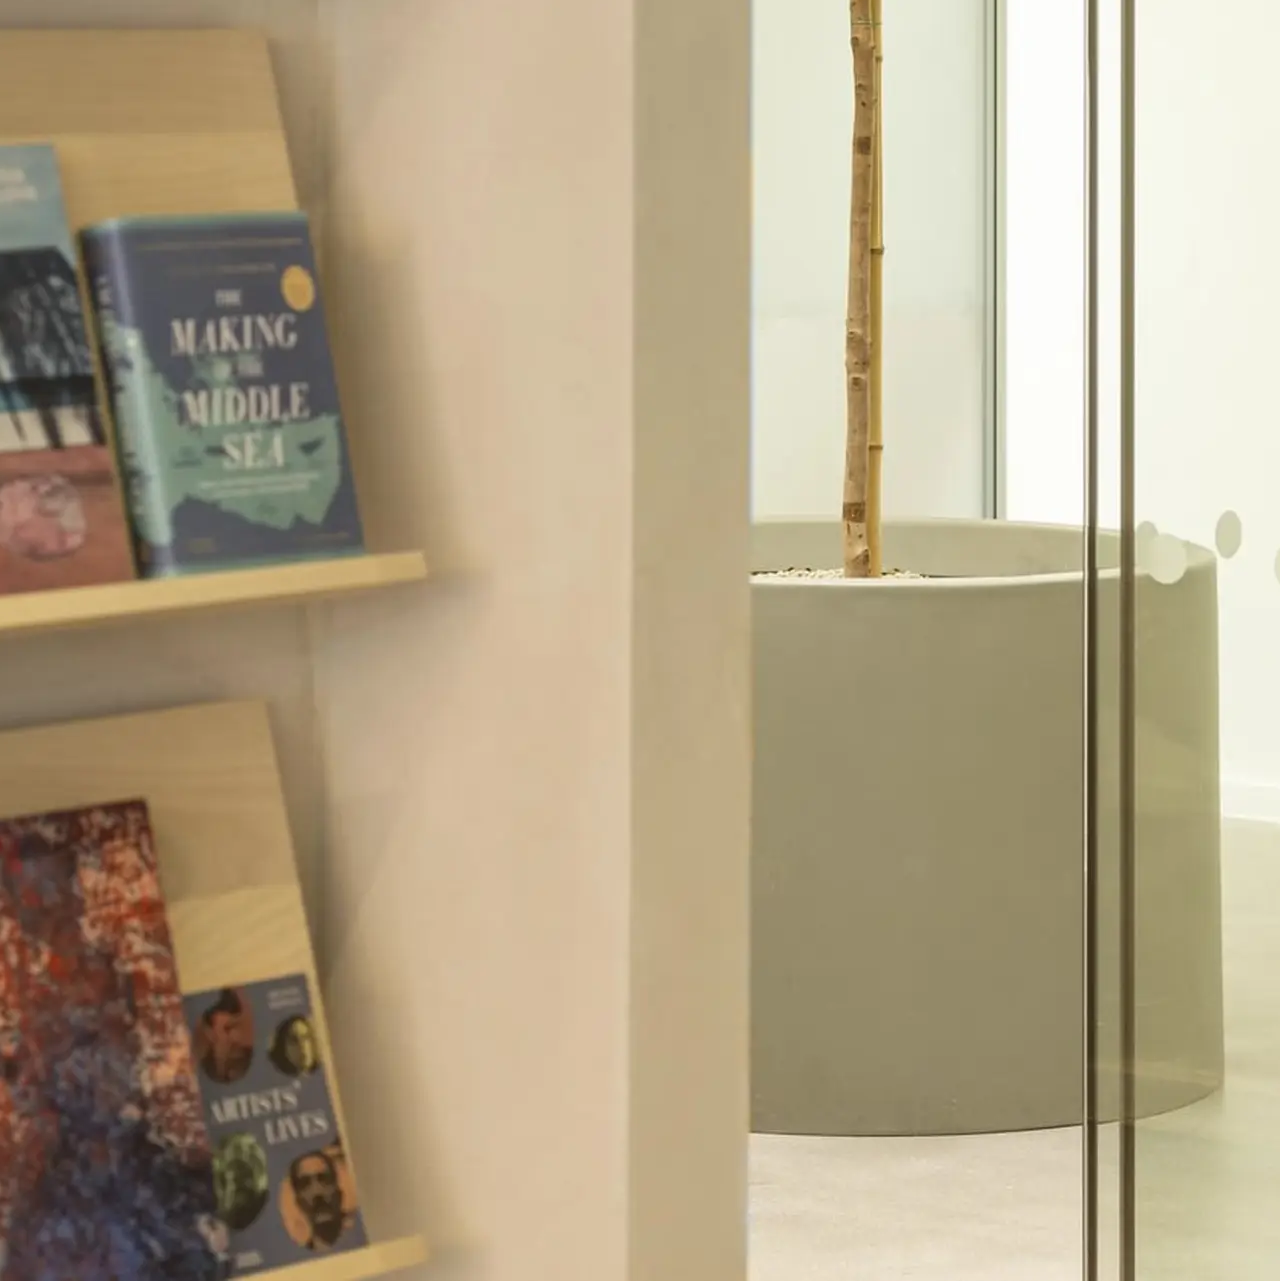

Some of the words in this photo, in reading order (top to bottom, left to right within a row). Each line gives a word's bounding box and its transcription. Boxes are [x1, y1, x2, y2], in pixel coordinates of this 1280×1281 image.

[170, 312, 299, 357] MAKING
[180, 380, 312, 428] MIDDLE
[221, 428, 286, 471] SEA
[263, 1108, 329, 1146] LIVES
